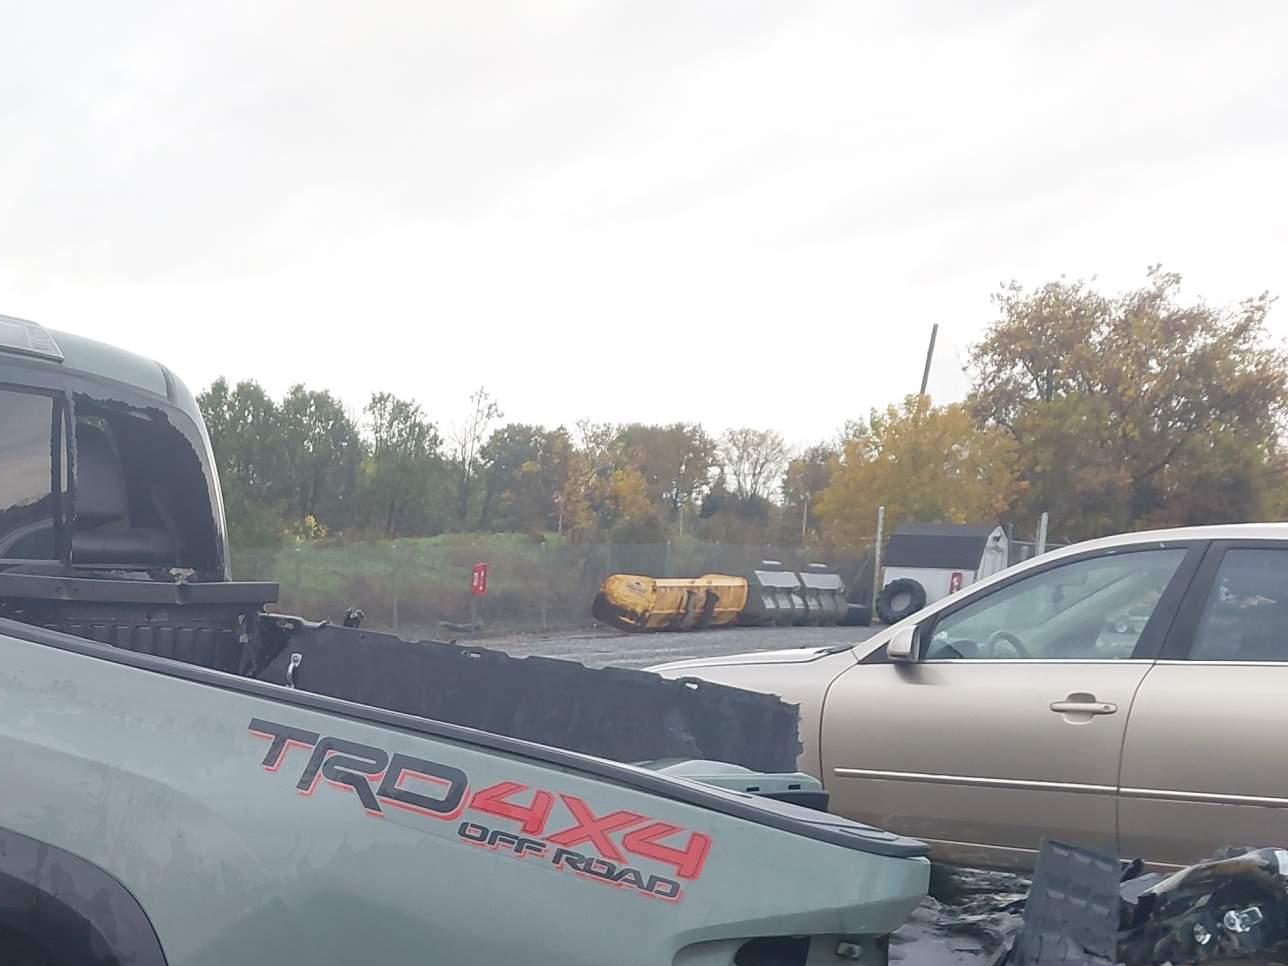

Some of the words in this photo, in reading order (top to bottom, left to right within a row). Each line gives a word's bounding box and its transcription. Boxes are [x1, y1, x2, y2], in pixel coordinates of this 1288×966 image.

[248, 717, 470, 822] TRD
[468, 780, 713, 880] 4X4
[456, 820, 547, 859] OFF
[550, 847, 685, 904] ROAD
